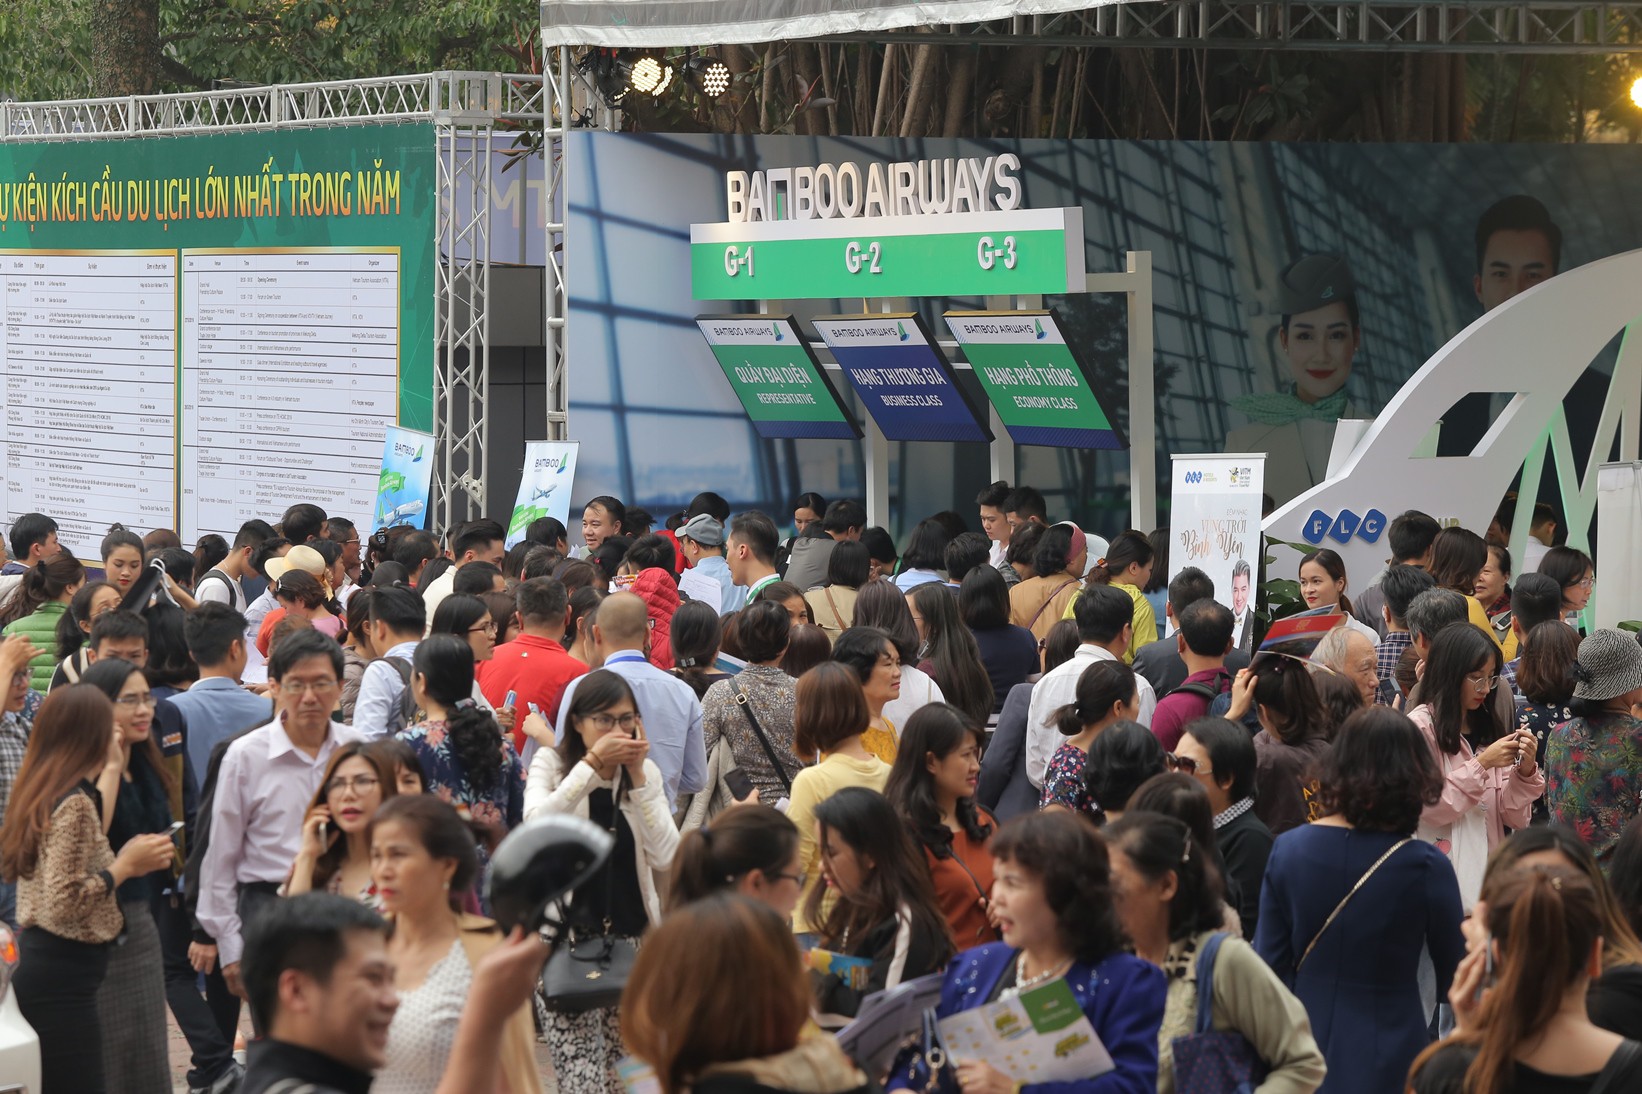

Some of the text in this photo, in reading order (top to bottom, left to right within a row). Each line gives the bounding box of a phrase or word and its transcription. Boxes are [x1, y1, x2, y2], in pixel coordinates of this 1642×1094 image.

[13, 172, 47, 232] KIỆN
[51, 171, 87, 222] KÍCH
[91, 164, 123, 222] CẦU
[127, 180, 151, 221] DU
[155, 177, 191, 231] LỊCH
[195, 165, 229, 219] LỚN
[234, 156, 284, 218] NHẤT
[288, 171, 352, 217] TRONG
[357, 158, 400, 215] NĂM
[864, 153, 1020, 220] AIRWAYS
[724, 245, 755, 277] G-1
[845, 241, 883, 273] G-2
[977, 235, 1017, 270] G-3
[713, 327, 773, 337] BAMBOO AIRWAYS
[831, 328, 897, 338] BAMBOO AIRWAYS
[964, 324, 1034, 335] BAMBOO AIRWAYS
[734, 360, 813, 388] QUẦY ĐẠI DIỆN
[850, 366, 948, 390] HẠNG THƯƠNG GIA
[983, 367, 1019, 390] HẠNG
[1037, 363, 1079, 388] THÔNG
[756, 393, 817, 405] REPRESENTATIVE
[880, 395, 944, 407] BUSINESS CLASS
[1012, 396, 1078, 410] ECONOMY CLASS
[534, 458, 560, 468] BAMBOO
